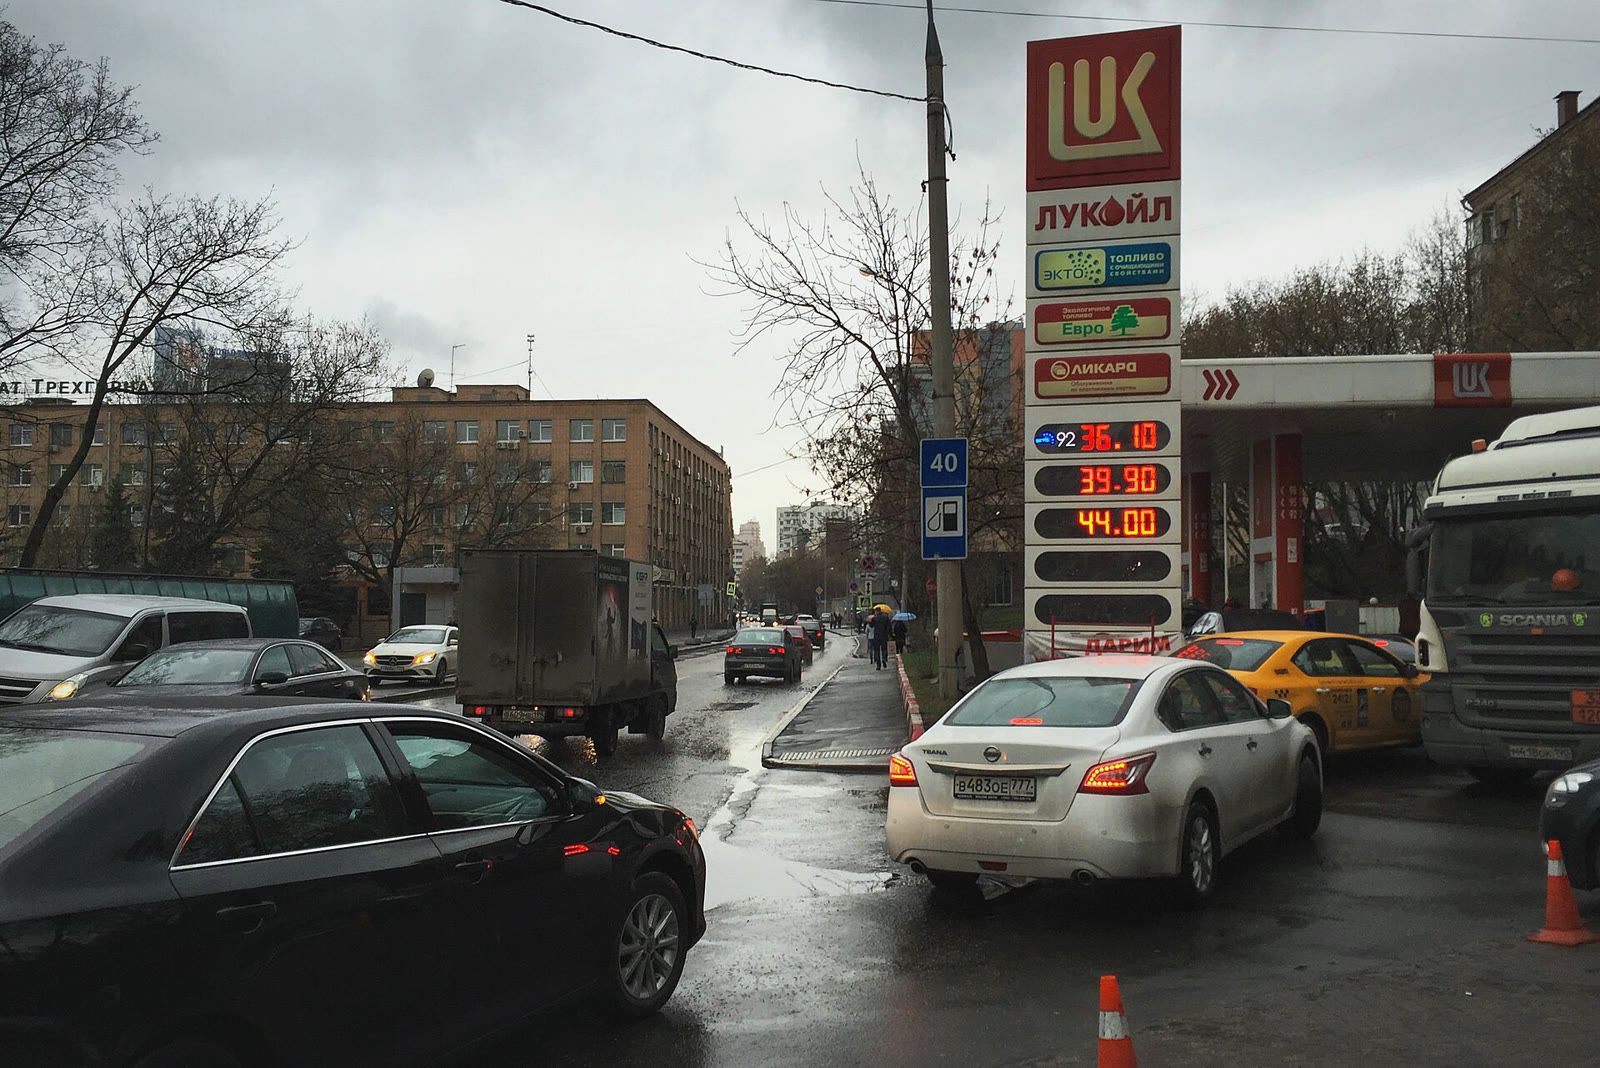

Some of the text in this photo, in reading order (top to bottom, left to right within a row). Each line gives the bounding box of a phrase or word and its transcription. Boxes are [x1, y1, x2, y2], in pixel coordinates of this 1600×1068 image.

[1035, 192, 1172, 231] ЛУКОЙЛ
[1110, 252, 1165, 263] ТОПЛИВО
[1043, 267, 1084, 281] ЭКТО
[1062, 306, 1111, 314] Экологичное
[1062, 312, 1093, 320] топливо
[1062, 322, 1104, 338] Евро
[1056, 422, 1157, 451] 92 36.10
[930, 453, 958, 472] 40
[1079, 465, 1157, 494] 39.90
[1078, 508, 1157, 536] 44.00
[1500, 613, 1569, 627] SCANIA
[1085, 636, 1171, 656] ДАРИМ
[922, 748, 948, 756] TEANA
[1011, 778, 1031, 791] 777
